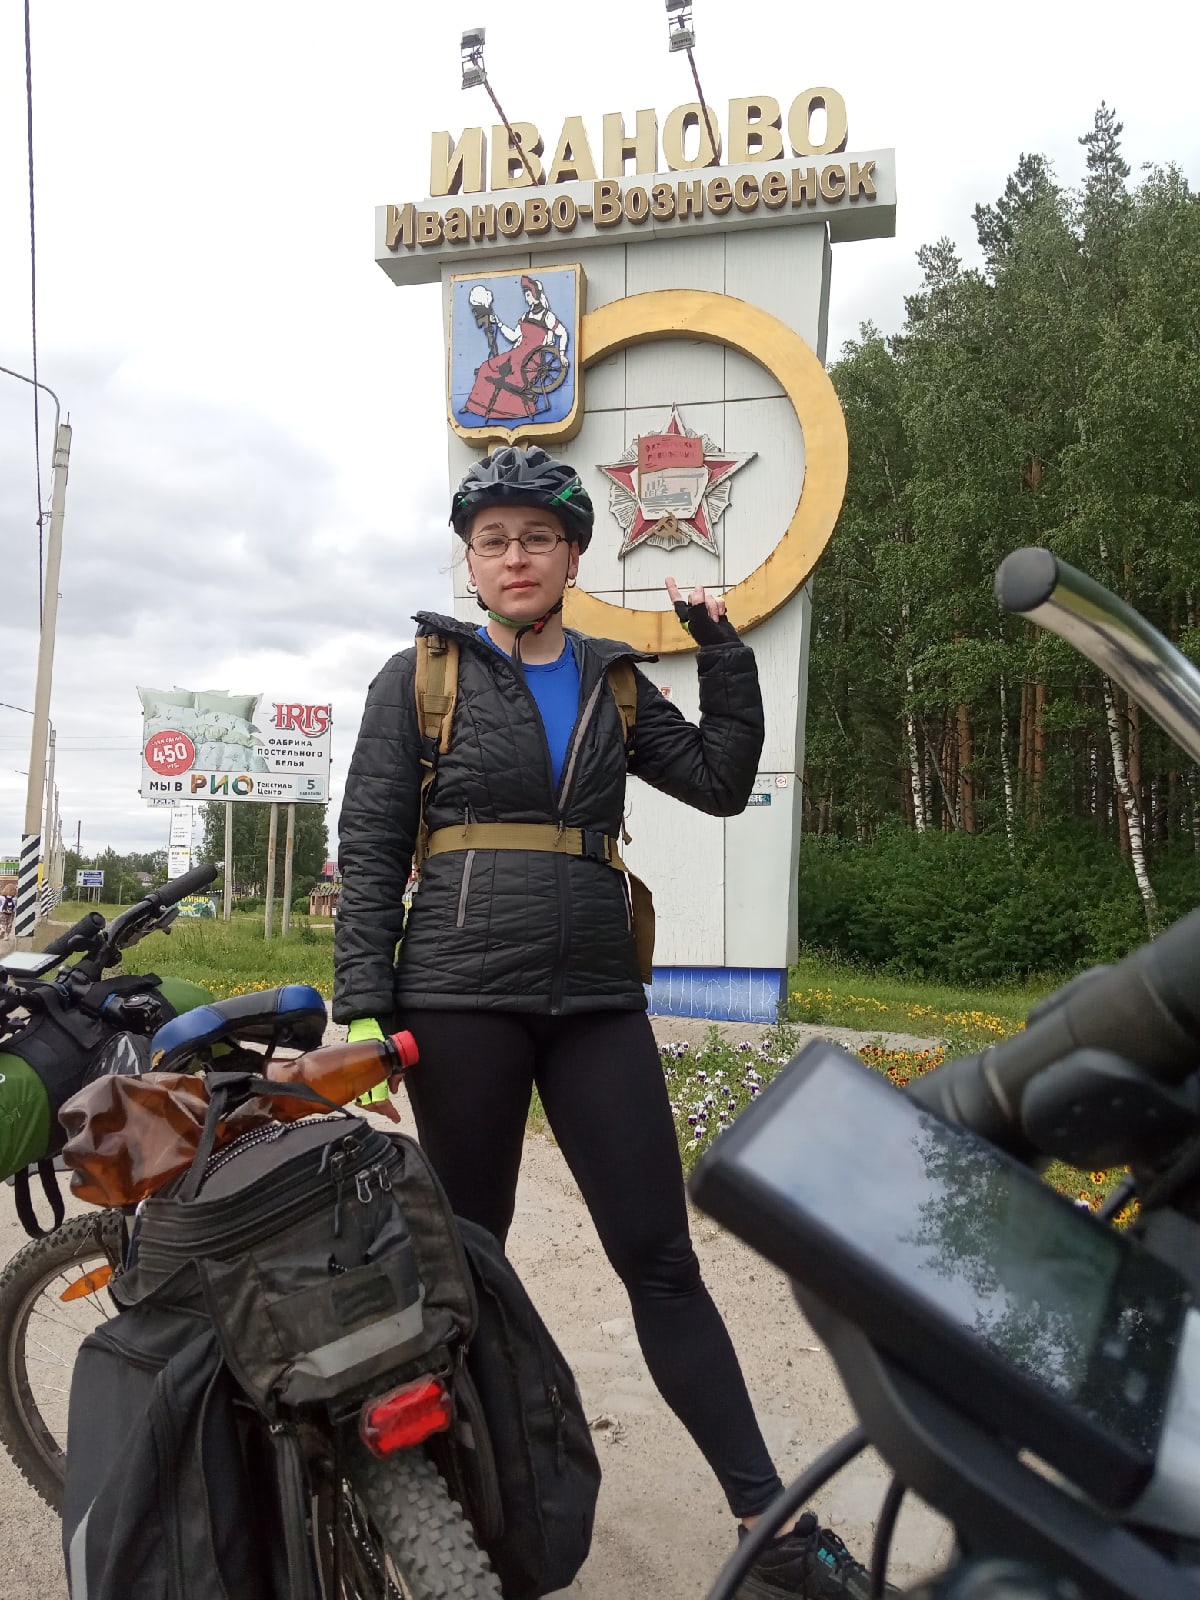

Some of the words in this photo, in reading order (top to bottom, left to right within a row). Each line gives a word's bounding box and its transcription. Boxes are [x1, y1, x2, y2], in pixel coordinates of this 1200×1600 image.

[430, 86, 848, 197] ИВАНОВО
[385, 160, 877, 251] Иваново-Вознесенск
[274, 703, 330, 737] IRIS
[153, 742, 188, 764] 450
[257, 748, 323, 758] ПОСТЕЛЬНОГО
[268, 738, 313, 747] ФАБРИКА
[275, 759, 305, 767] БЕЛЬЯ
[149, 781, 171, 791] МЫ
[174, 782, 183, 792] В
[191, 774, 254, 796] РИО
[306, 779, 316, 790] 5
